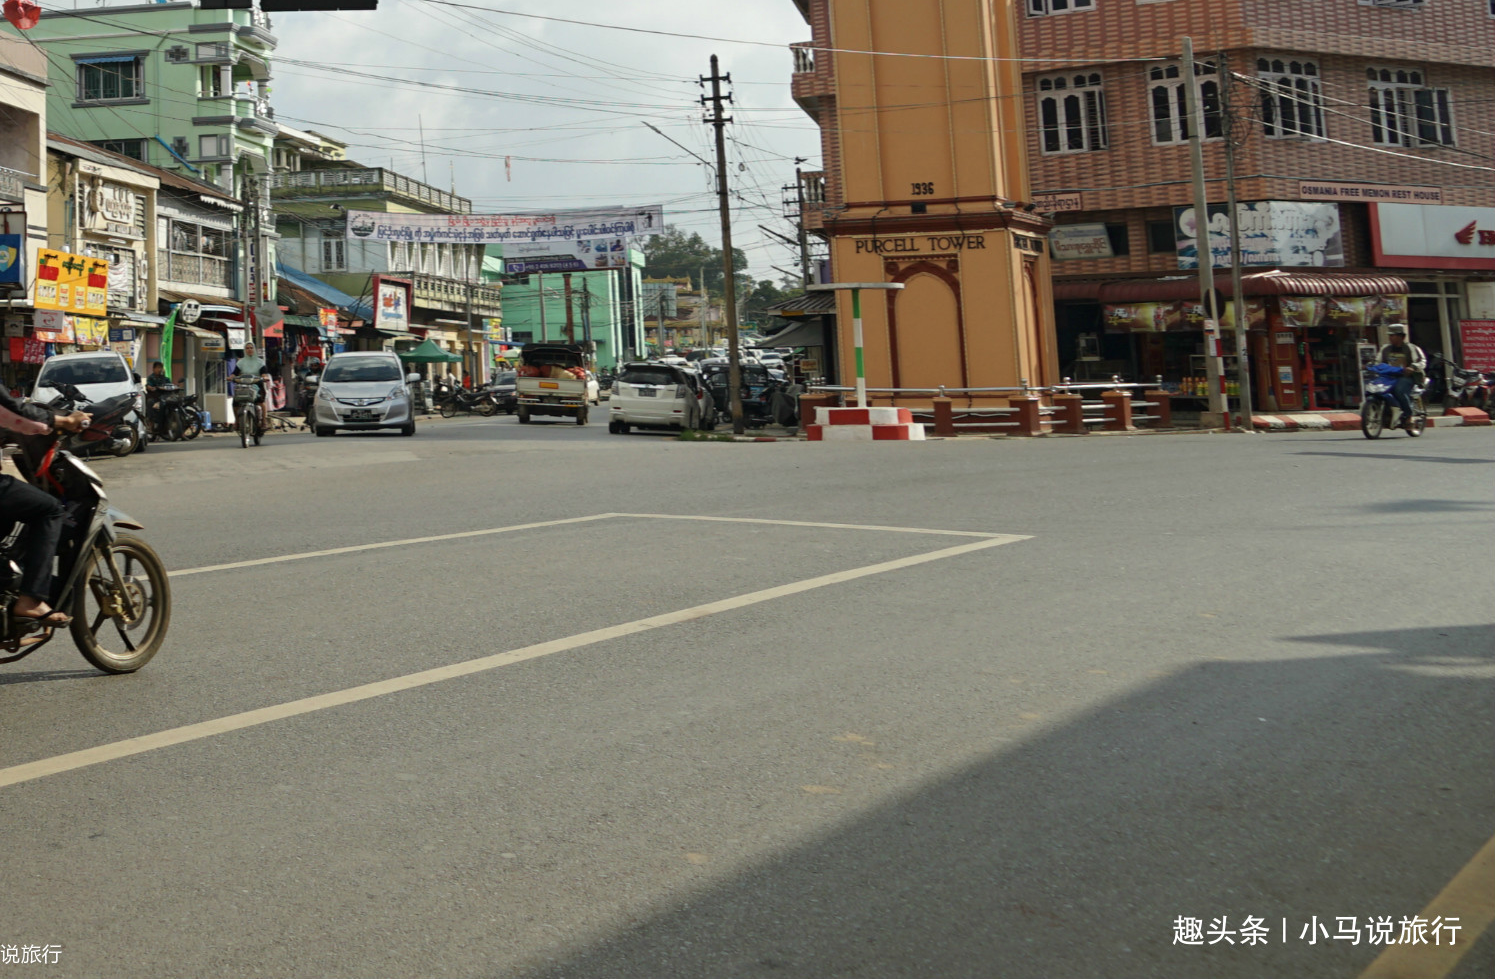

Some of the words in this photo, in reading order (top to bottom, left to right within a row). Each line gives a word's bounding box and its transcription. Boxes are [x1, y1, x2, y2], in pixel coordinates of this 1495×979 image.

[911, 182, 935, 195] 1936
[1301, 185, 1338, 196] OSMANIA
[1340, 187, 1360, 197] FREE
[1362, 188, 1390, 198] MEMON
[1392, 189, 1411, 199] REST
[1413, 190, 1441, 201] HOUSE
[856, 237, 920, 254] PURCELL
[927, 235, 986, 251] TOWER
